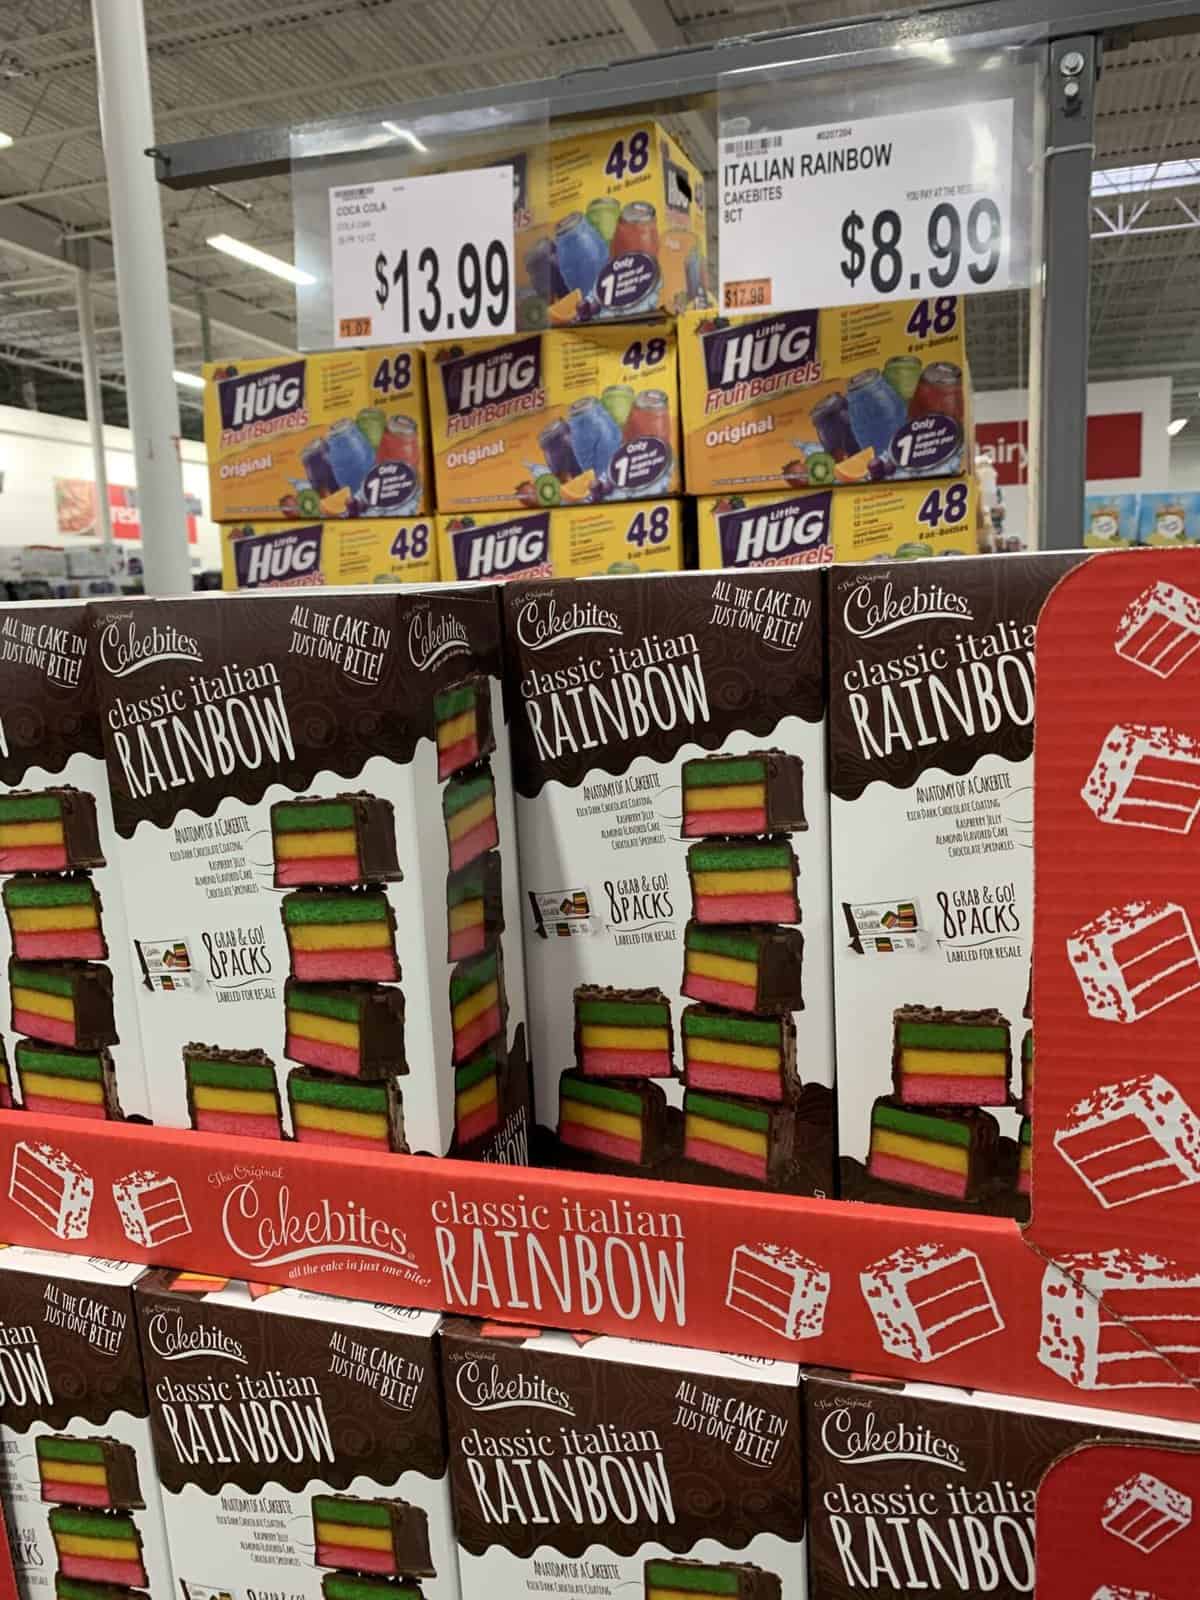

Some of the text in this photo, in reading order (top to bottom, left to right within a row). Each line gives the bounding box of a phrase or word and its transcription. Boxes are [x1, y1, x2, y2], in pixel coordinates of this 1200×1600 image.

[604, 131, 649, 179] 48
[724, 143, 892, 186] ITALIAN RAINBOW
[336, 202, 387, 217] COCA COLA
[724, 185, 782, 206] CAKEBITES
[724, 208, 743, 223] 8CT
[613, 257, 634, 270] Only
[840, 198, 1001, 293] $8.99
[375, 239, 509, 333] $13.99
[601, 274, 615, 306] 1
[756, 322, 786, 337] Little
[907, 295, 958, 338] 48
[373, 353, 412, 393] 48
[487, 353, 513, 366] Little
[622, 338, 667, 370] 48
[706, 416, 773, 446] Original
[911, 418, 936, 431] Only
[220, 456, 272, 479] Original
[447, 440, 504, 468] Original
[626, 441, 648, 453] Only
[897, 434, 912, 466] 1
[368, 477, 381, 506] 1
[378, 465, 397, 476] Only
[614, 456, 630, 487] 1
[627, 506, 669, 547] 48
[770, 505, 800, 521] Little
[918, 483, 968, 527] 48
[390, 524, 429, 561] 48
[711, 580, 812, 619] ALL THE CAKE IN
[844, 582, 968, 635] Cakebites
[290, 605, 391, 649] ALL THE CAKE IN
[517, 599, 619, 649] Cakebites
[709, 604, 804, 649] JUST ONE BITE!
[100, 622, 200, 674] Cakebites
[288, 631, 384, 682] JUST ONE BITE!
[520, 656, 605, 699] classic
[608, 632, 700, 675] italian
[843, 620, 1037, 692] classic italia
[108, 662, 281, 730] classic italian
[525, 653, 711, 761] RAINBOW
[849, 651, 1037, 760] RAINBO
[113, 685, 295, 799] RAINBOW
[916, 784, 954, 804] ANATOMY
[955, 783, 967, 799] OF
[973, 773, 1012, 795] CAKEBITE
[604, 880, 622, 925] 8
[620, 891, 674, 924] PACKS
[617, 873, 669, 896] GRAB & GO!
[952, 882, 1016, 908] GRAB & GO!
[937, 891, 1020, 938] 8 PACKS
[614, 930, 677, 947] LABELED FOR RESALE
[947, 945, 1022, 963] LABELED FOR RESALE
[208, 1166, 285, 1188] The Original
[222, 1180, 408, 1260] Cakebites
[431, 1190, 687, 1240] classic italian
[288, 1260, 432, 1287] all the cake in just one bite!
[435, 1225, 687, 1328] RAINBOW
[44, 1283, 126, 1329] ALL THE CAKE IN
[44, 1304, 122, 1353] JUST ONE BITE!
[149, 1312, 243, 1358] Cakebites
[329, 1331, 424, 1383] ALL THE CAKE IN
[156, 1371, 321, 1402] classic italian
[328, 1355, 419, 1409] JUST ONE BITE!
[456, 1360, 570, 1409] Cakebites
[675, 1380, 788, 1438] ALL THE CAKE IN
[162, 1397, 336, 1465] RAINBOW
[461, 1424, 663, 1457] classic italian
[673, 1405, 779, 1466] JUST ONE BITE!
[822, 1407, 960, 1465] Cakebites
[466, 1452, 676, 1525] RAINBOW
[823, 1481, 1036, 1515] classic italia
[830, 1515, 1036, 1592] RAINBO
